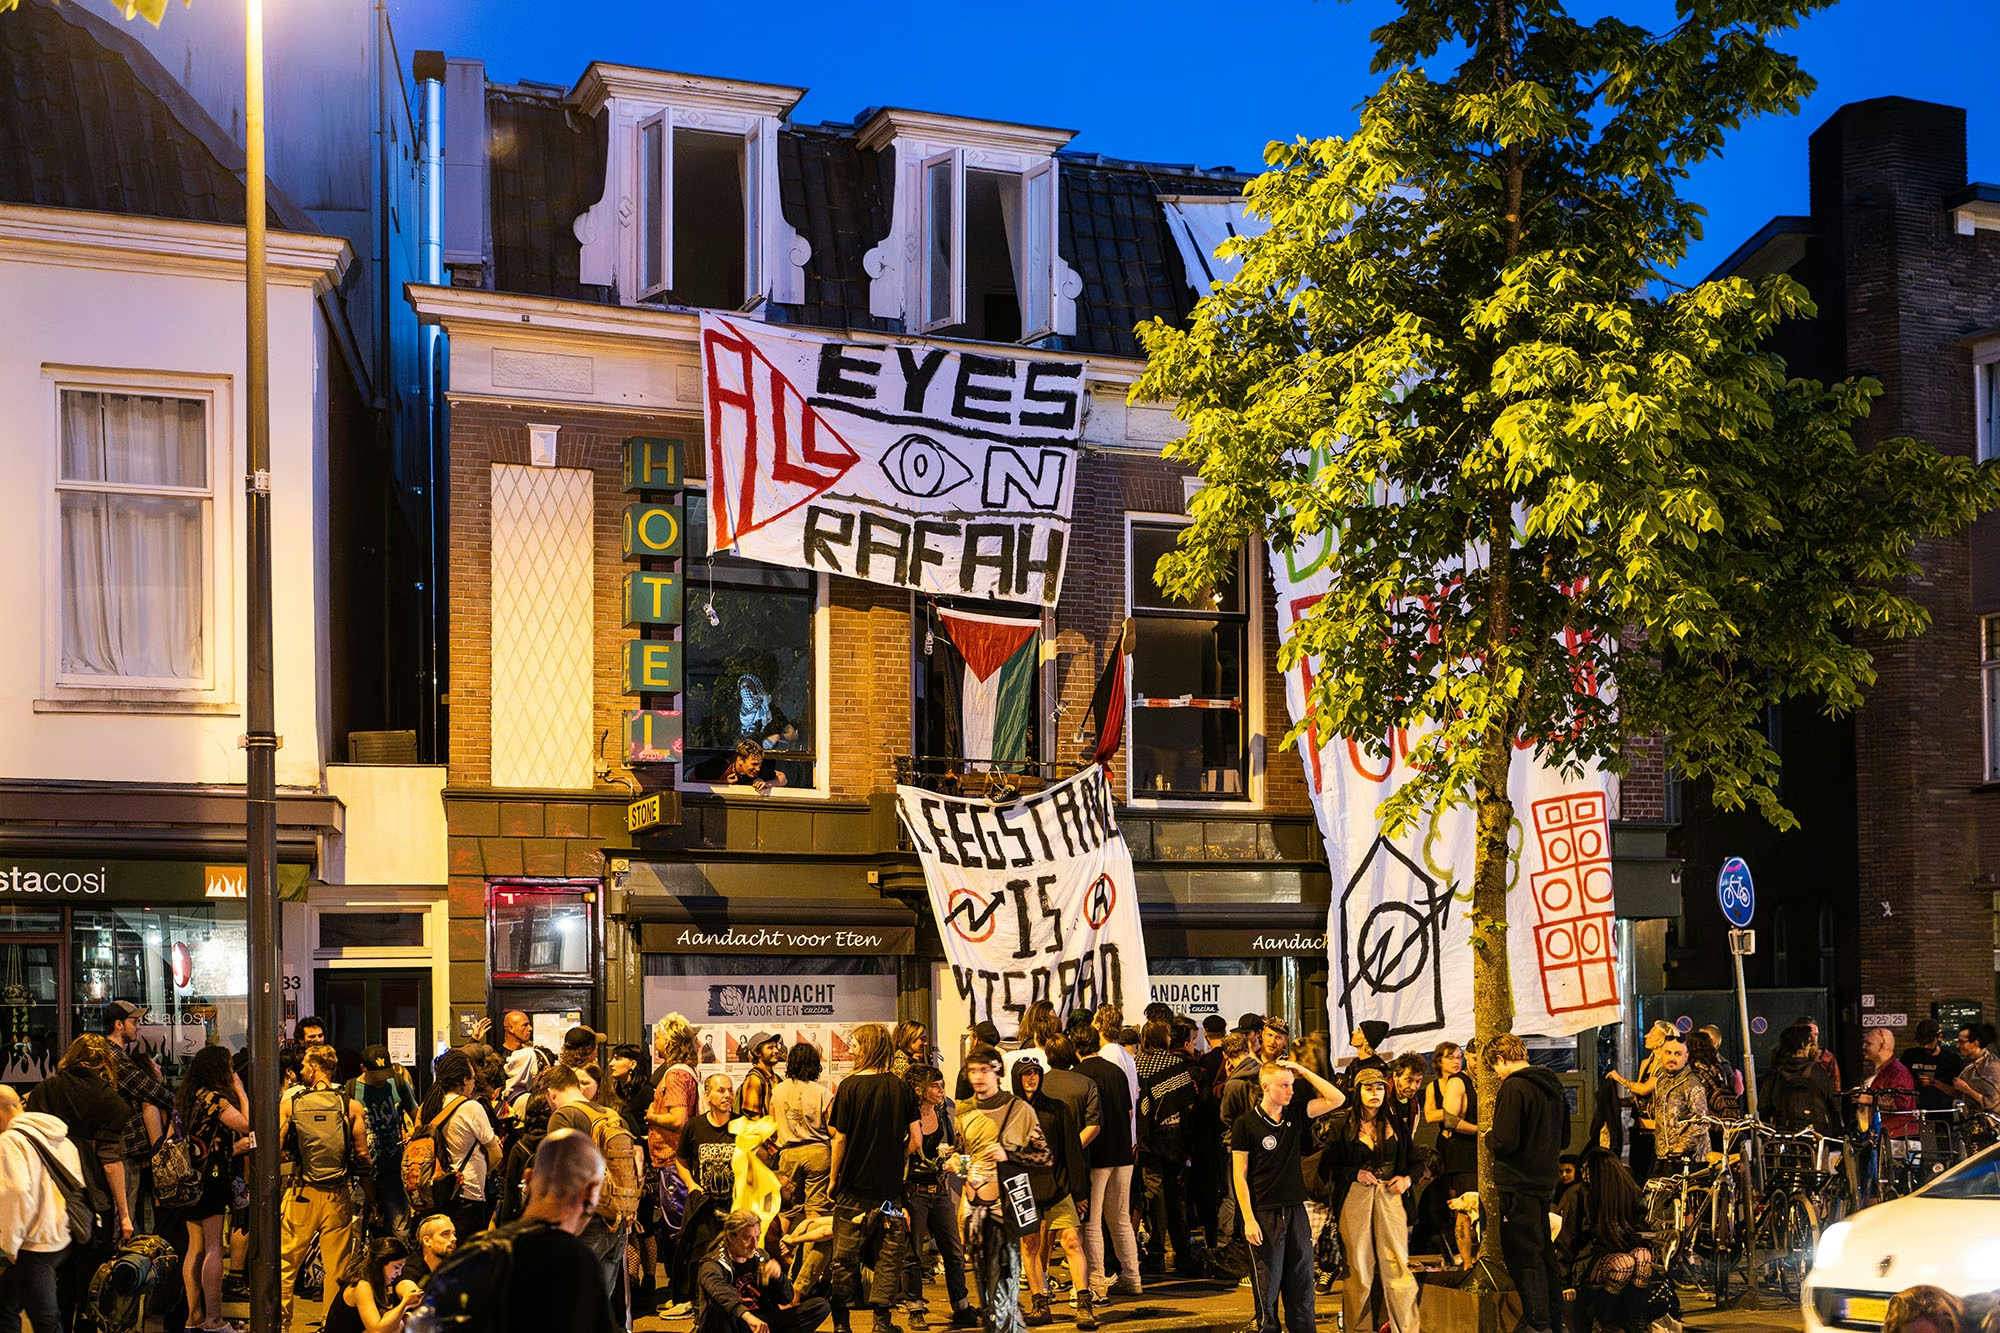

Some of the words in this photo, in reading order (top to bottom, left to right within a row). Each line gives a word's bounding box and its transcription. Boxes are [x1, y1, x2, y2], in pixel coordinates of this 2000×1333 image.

[817, 344, 1084, 430] EYES
[704, 328, 860, 550] ALL
[803, 505, 1064, 603] RAFAH
[638, 442, 679, 756] HOTEL
[631, 799, 657, 828] STONE
[676, 928, 784, 947] Aandacht
[786, 932, 832, 947] voor
[835, 930, 883, 948] Eten
[1006, 874, 1063, 959] IS
[746, 1005, 772, 1017] VOOR
[775, 1005, 799, 1017] ETEN
[747, 984, 836, 1004] AANDACHT
[1863, 996, 1873, 1006] 27
